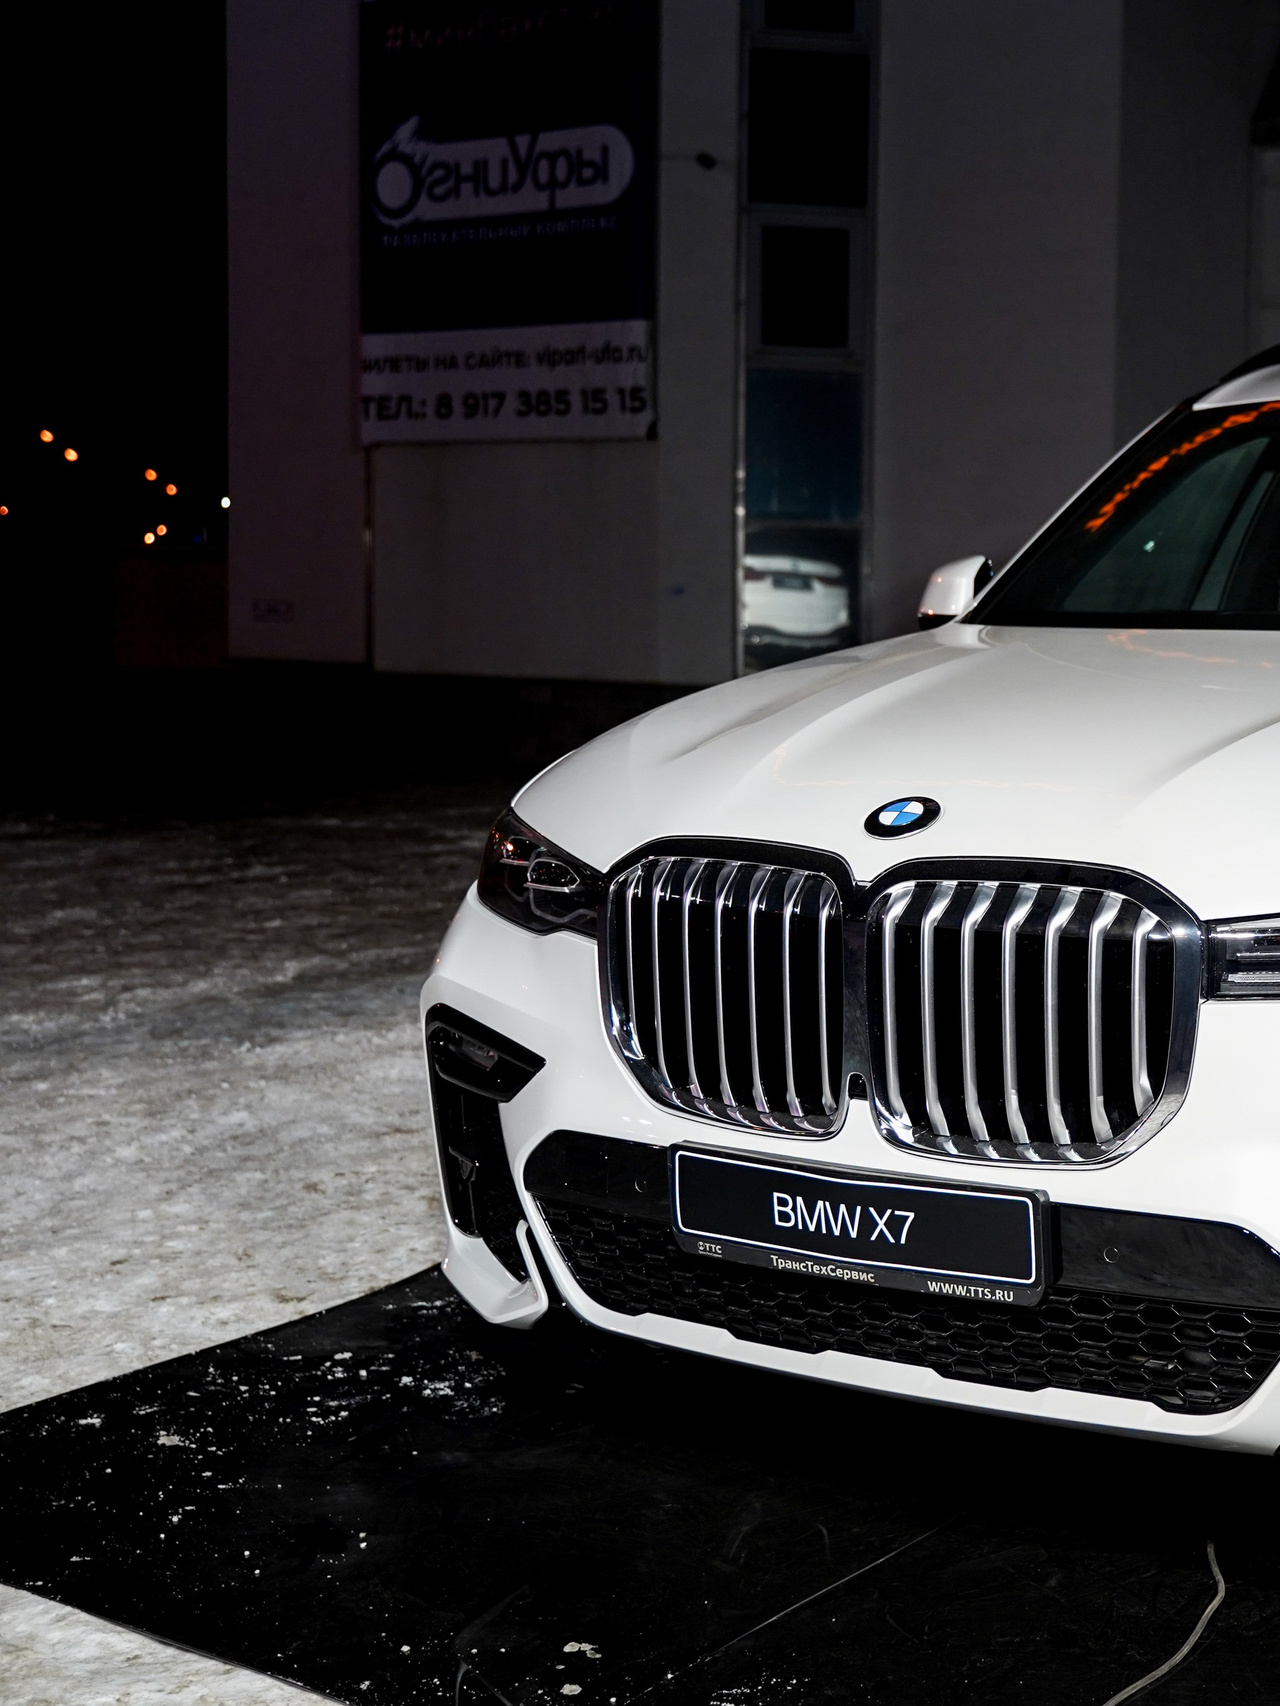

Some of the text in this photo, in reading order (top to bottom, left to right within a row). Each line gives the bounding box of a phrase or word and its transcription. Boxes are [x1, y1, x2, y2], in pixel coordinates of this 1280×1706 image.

[434, 352, 459, 370] НА
[464, 346, 530, 370] САЙТЕ:
[361, 386, 648, 420] ТЕЛ.: 8 917 385 15 15
[772, 1191, 916, 1245] BMW X7
[771, 1254, 876, 1283] ТрансТехСервис
[927, 1280, 1015, 1303] WWW.TTS.RU
